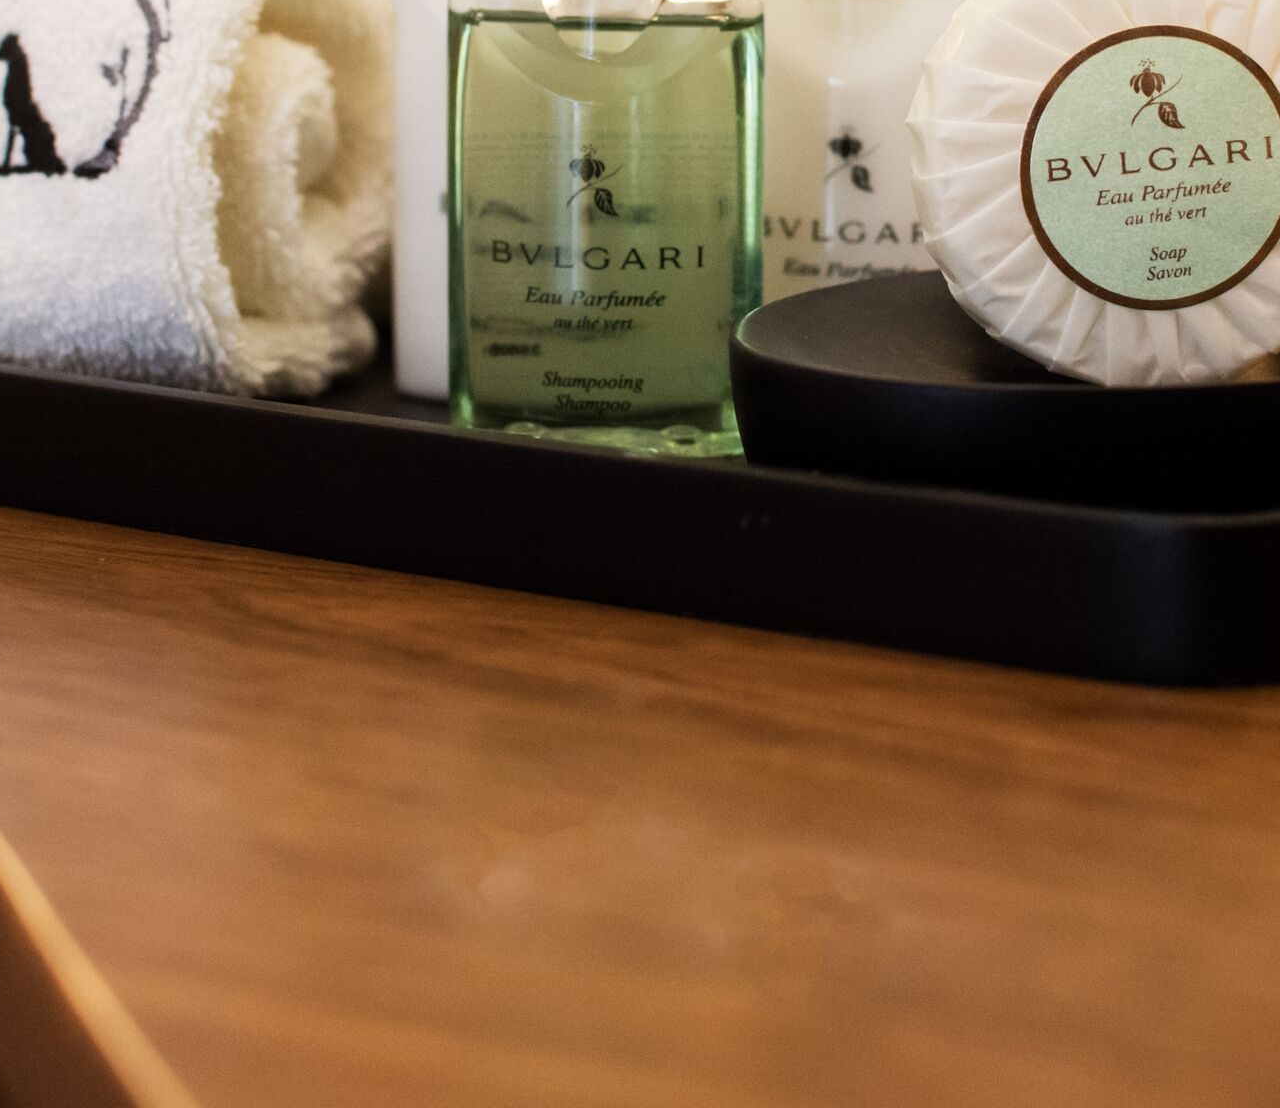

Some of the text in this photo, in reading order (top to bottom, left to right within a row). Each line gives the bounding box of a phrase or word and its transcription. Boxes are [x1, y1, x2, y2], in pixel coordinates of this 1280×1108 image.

[1046, 136, 1274, 182] BVLGARI
[1096, 177, 1232, 206] Eau Parfumée
[1125, 206, 1207, 226] au thé vert
[491, 239, 705, 271] BVLGARI
[1149, 246, 1187, 262] Soap
[1146, 266, 1192, 281] Savon
[526, 286, 666, 311] Eau Parfumée
[554, 317, 572, 329] au
[542, 371, 644, 392] Shampooing
[555, 395, 632, 414] Shampoo
